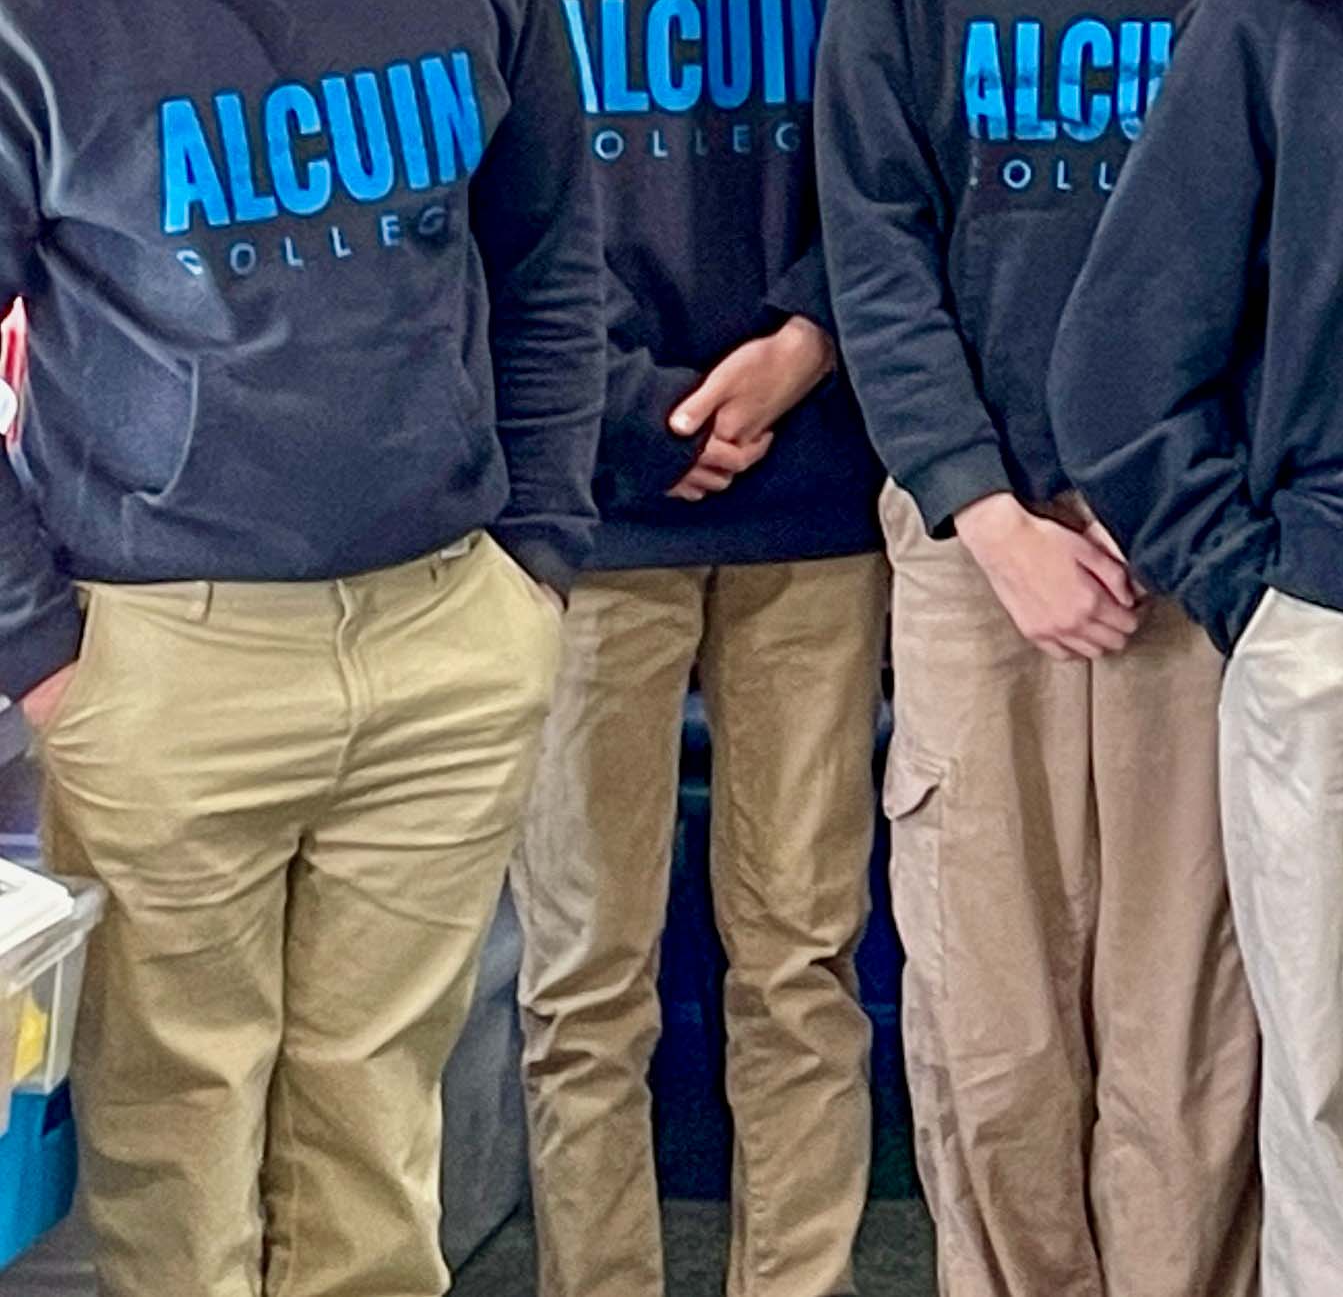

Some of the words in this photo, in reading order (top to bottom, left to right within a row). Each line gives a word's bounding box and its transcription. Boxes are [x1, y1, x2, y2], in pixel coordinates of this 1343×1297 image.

[963, 18, 1174, 142] ALCU
[162, 50, 485, 234] ALCUIN
[594, 122, 800, 160] OLLEG
[176, 205, 449, 276] COLLEG
